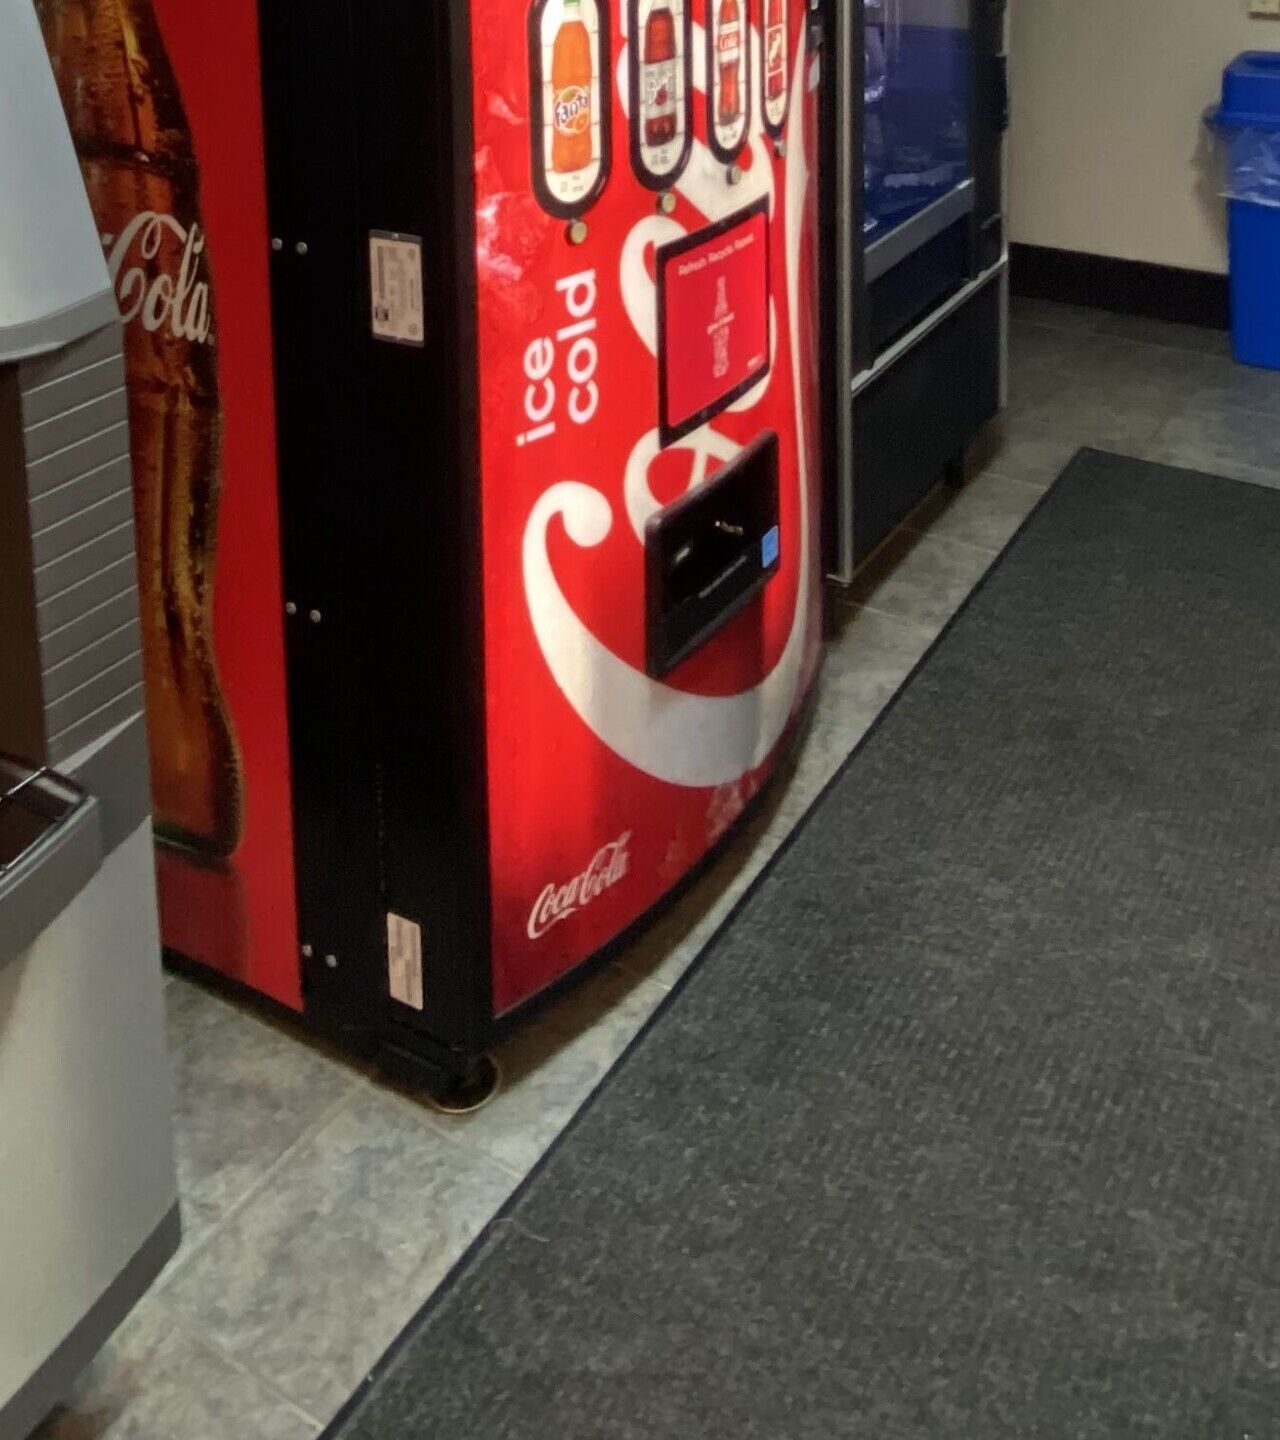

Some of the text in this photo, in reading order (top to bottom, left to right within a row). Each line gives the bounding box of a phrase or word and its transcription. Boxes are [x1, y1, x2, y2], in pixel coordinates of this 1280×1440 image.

[516, 336, 556, 447] ice
[555, 268, 599, 424] cold
[527, 828, 632, 940] Coca-Cola
